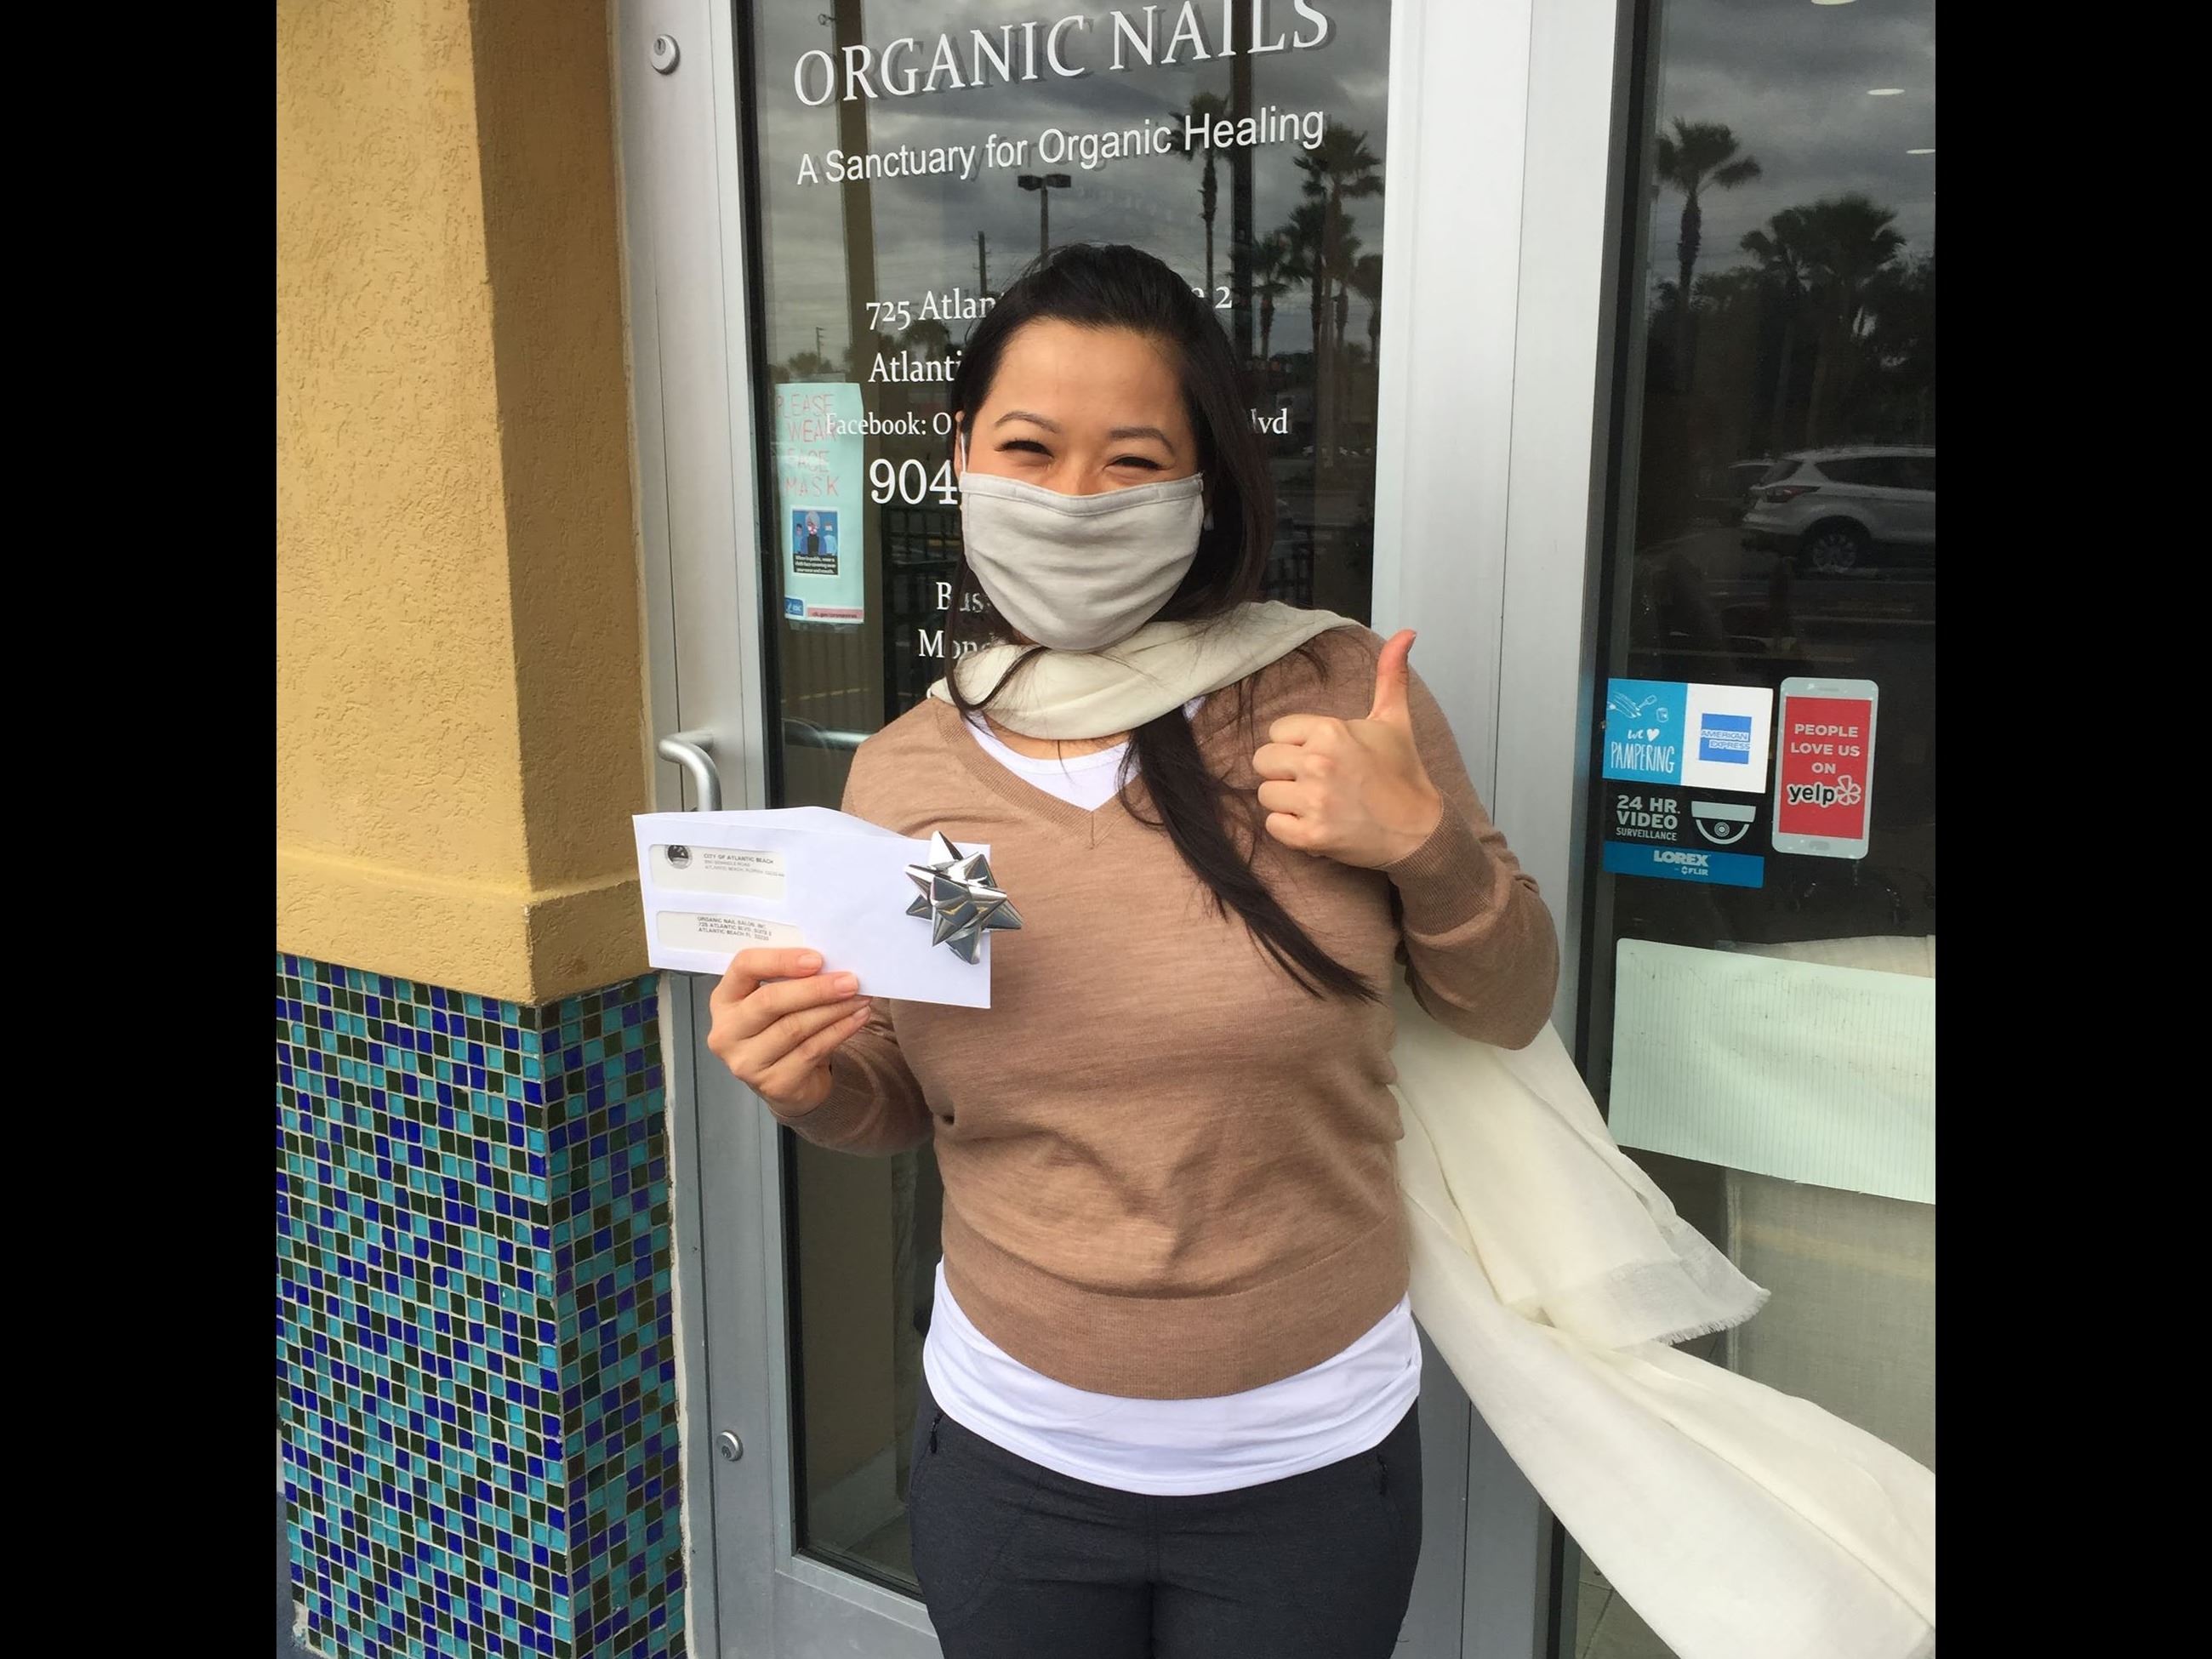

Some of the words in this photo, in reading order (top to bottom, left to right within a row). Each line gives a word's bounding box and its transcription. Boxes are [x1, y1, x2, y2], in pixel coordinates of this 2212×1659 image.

[794, 14, 1086, 106] ORGANIC
[1109, 0, 1328, 71] NAILS
[797, 153, 818, 185] A
[825, 145, 976, 182] Sanctuary
[986, 134, 1029, 168] for
[1039, 117, 1172, 170] Organic
[1184, 105, 1324, 150] Healing
[866, 300, 911, 331] 725
[918, 288, 1004, 321] Atlan
[1214, 286, 1233, 309] 2
[825, 412, 926, 436] Facebook:
[869, 458, 958, 505] 904
[1702, 730, 1748, 742] AMERICAN
[1794, 723, 1858, 738] PEOPLE
[1710, 739, 1750, 750] EXPRESS
[1791, 743, 1833, 755] LOVE
[1838, 745, 1861, 757] US
[1611, 742, 1675, 773] PAMPERING
[1811, 762, 1836, 774] ON
[1617, 795, 1643, 811] 24
[1650, 797, 1681, 814] HR.
[1789, 785, 1835, 805] yelp
[1616, 810, 1679, 830] VIDEO
[1616, 827, 1677, 841] SURVEILLANCE
[1653, 850, 1709, 868] LOREX
